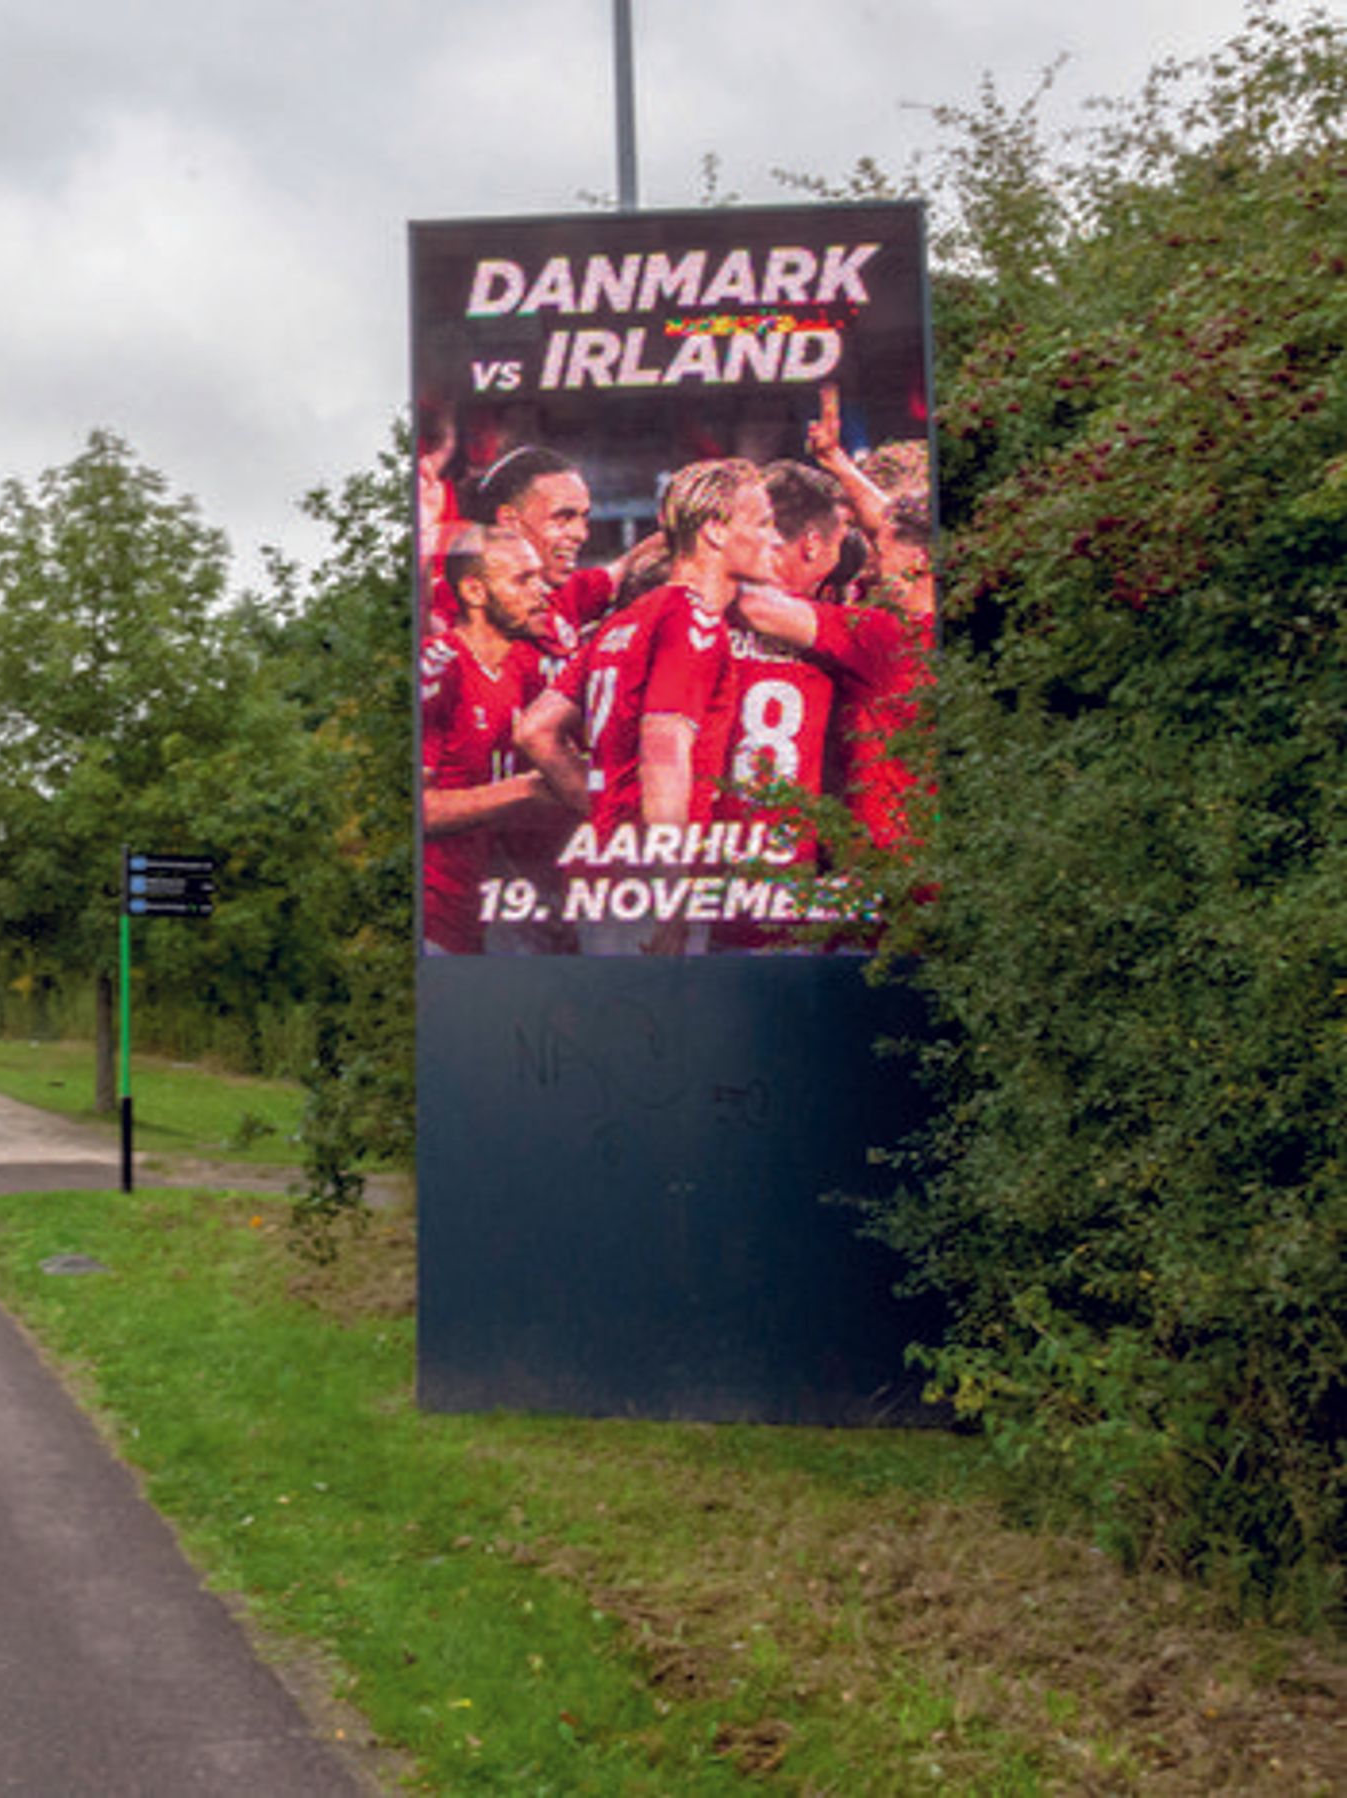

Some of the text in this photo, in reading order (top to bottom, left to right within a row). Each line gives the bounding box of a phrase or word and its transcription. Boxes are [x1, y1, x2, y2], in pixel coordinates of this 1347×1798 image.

[466, 243, 881, 318] DANMARK
[539, 326, 843, 389] IRLAND
[733, 679, 805, 806] 8
[558, 823, 798, 865] AARHUS
[478, 878, 549, 922] 19.
